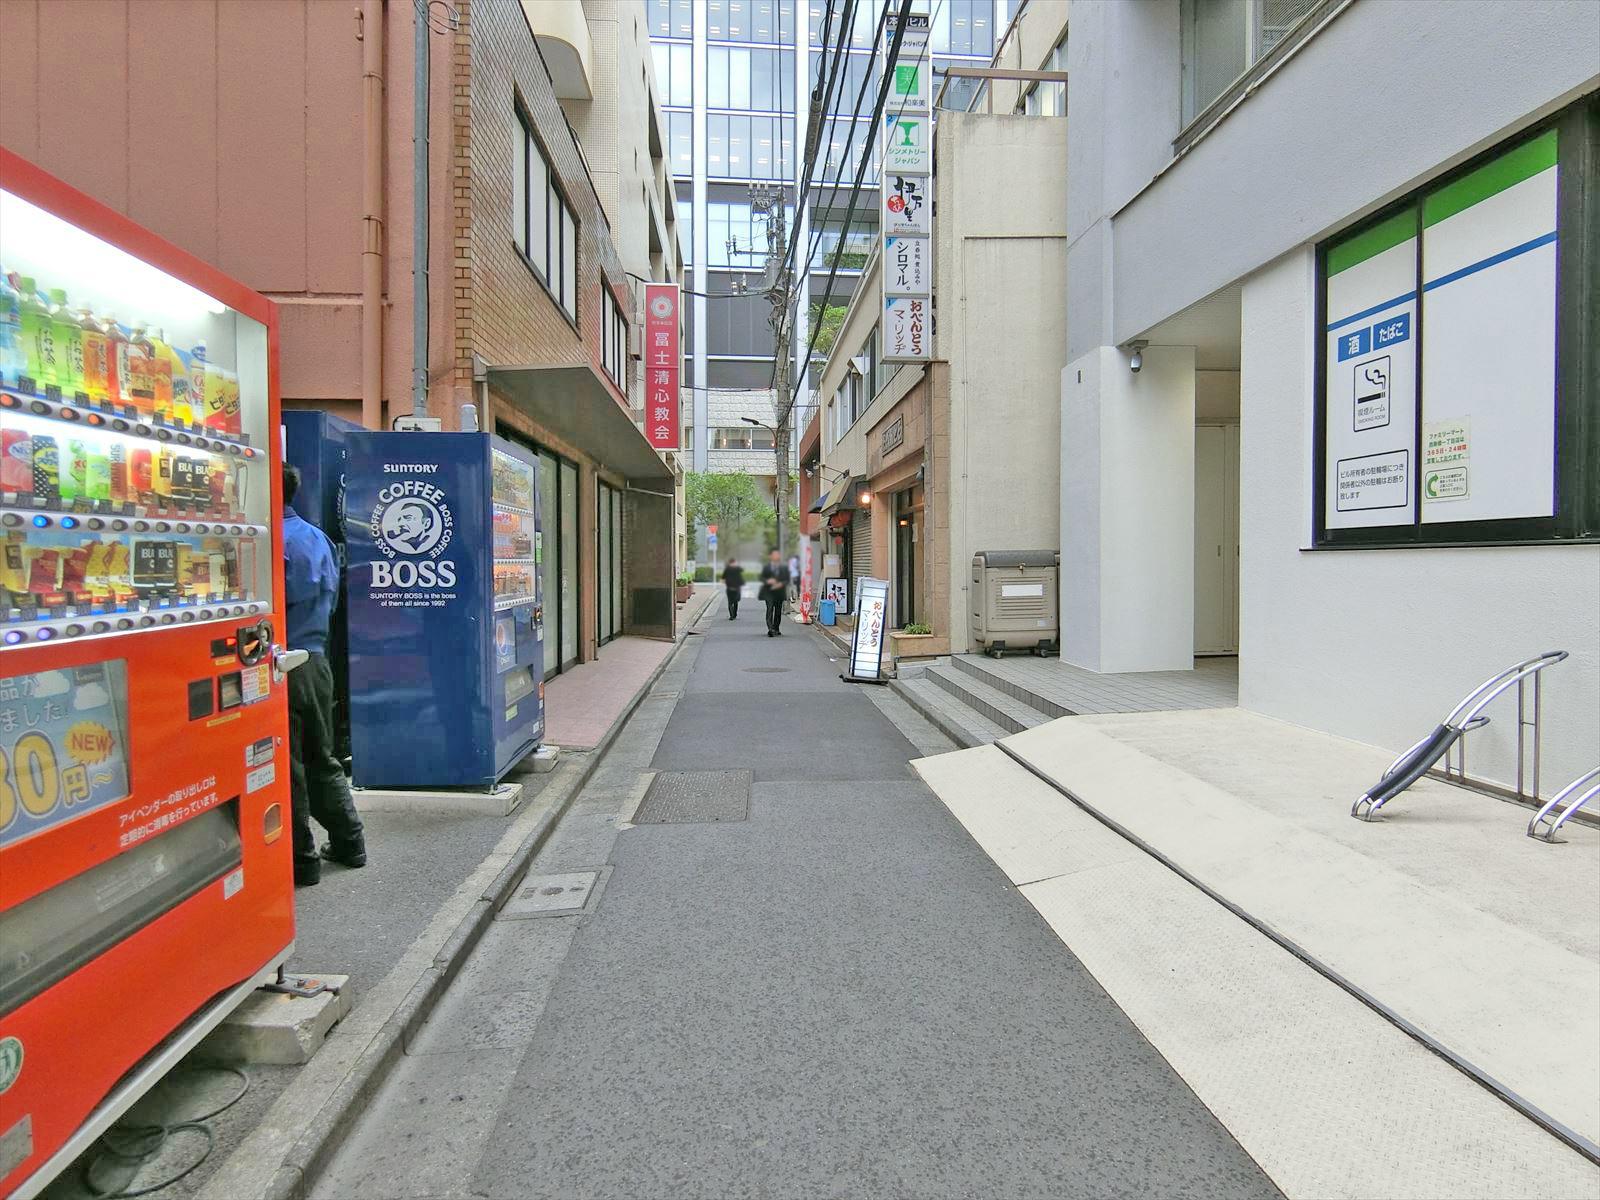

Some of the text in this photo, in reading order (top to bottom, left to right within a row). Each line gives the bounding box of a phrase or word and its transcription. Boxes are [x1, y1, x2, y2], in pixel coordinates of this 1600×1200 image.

[888, 16, 927, 27] 本ビル
[895, 157, 920, 165] ジャパン
[910, 300, 923, 355] おべんとう
[1348, 321, 1404, 355] 酒 たばこ
[383, 463, 439, 474] SUNTORY
[378, 480, 446, 504] COFFEE
[371, 503, 396, 559] BOSS COFFEE
[429, 504, 454, 559] BOSS COFFEE
[369, 560, 457, 589] BOSS
[870, 601, 883, 647] おべんとう
